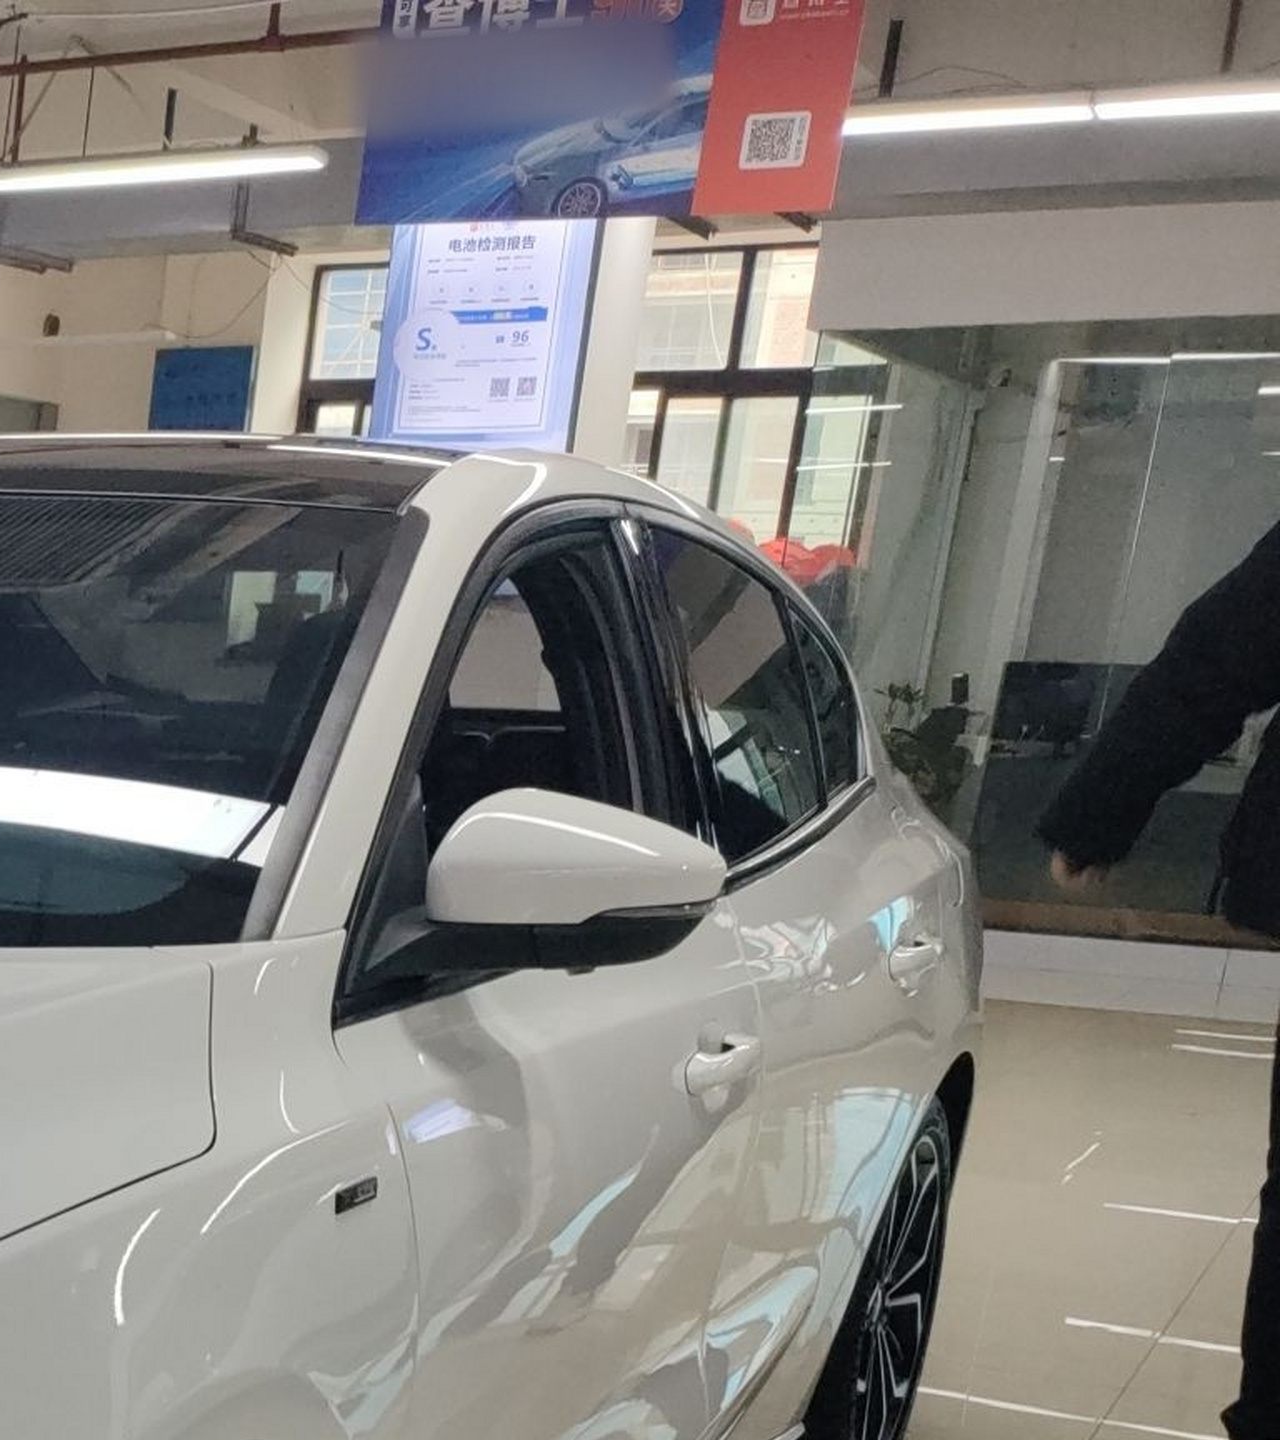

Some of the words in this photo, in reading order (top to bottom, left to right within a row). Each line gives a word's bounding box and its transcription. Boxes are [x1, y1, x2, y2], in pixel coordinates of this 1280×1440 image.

[448, 234, 536, 253] 电池检测报告
[416, 328, 432, 350] S
[512, 330, 529, 343] 96
